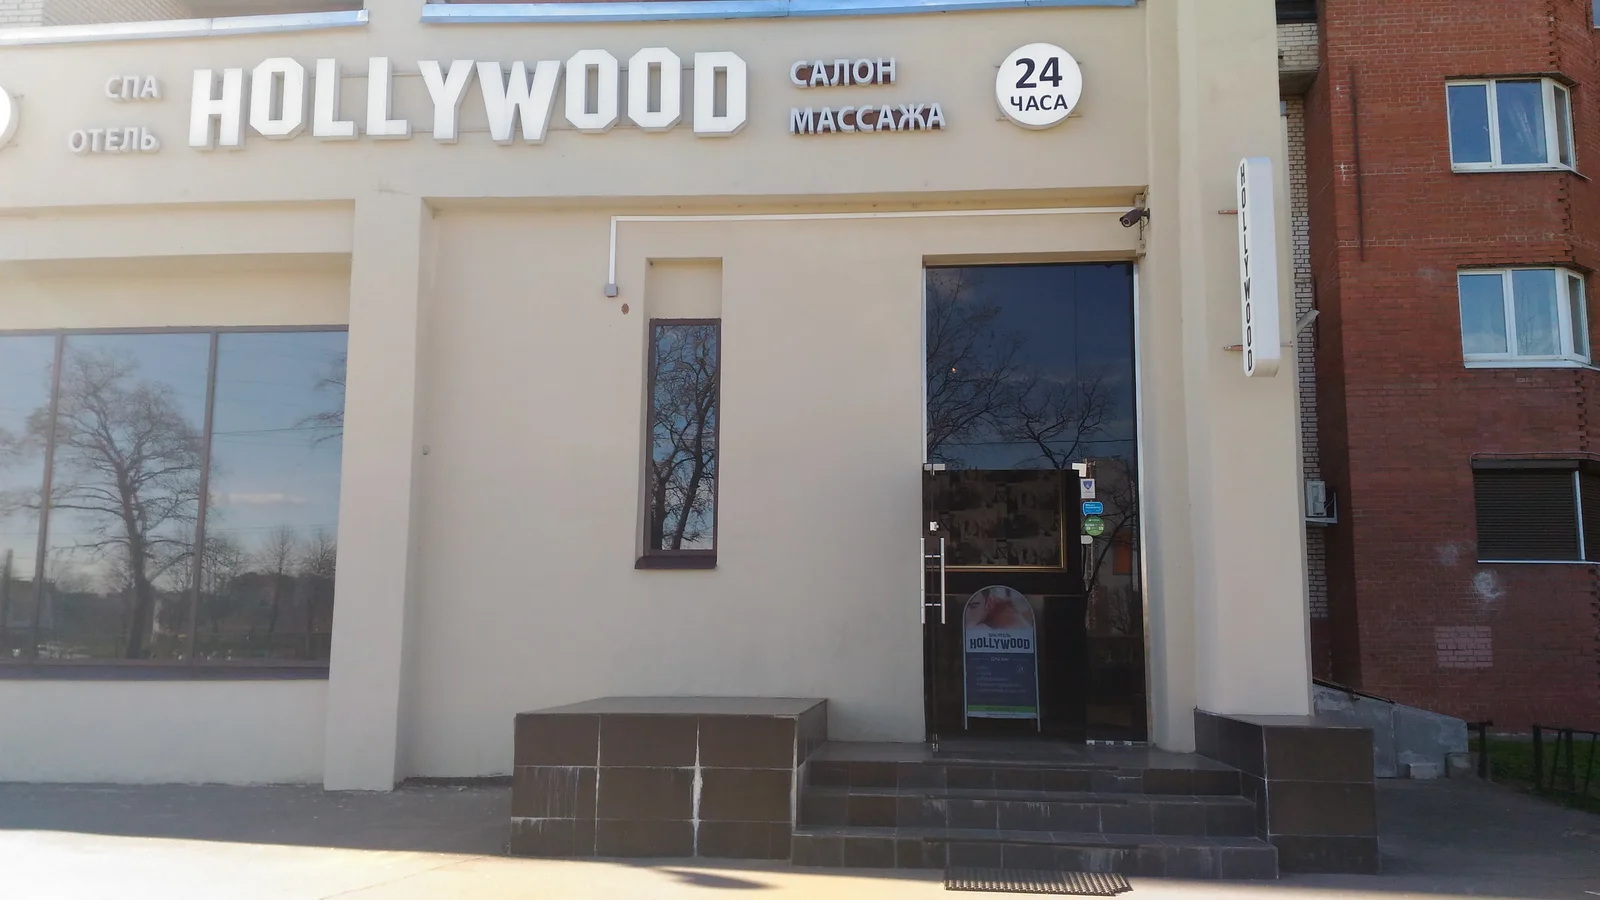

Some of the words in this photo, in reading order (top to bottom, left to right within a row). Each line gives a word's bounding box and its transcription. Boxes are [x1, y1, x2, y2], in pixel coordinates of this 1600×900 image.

[105, 74, 160, 100] СПА
[789, 57, 896, 87] САЛОН
[1015, 57, 1063, 89] 24
[188, 47, 748, 149] HOLLYWOOD
[1010, 94, 1069, 112] ЧАСА
[789, 102, 946, 134] МАССАЖА
[69, 126, 160, 153] ОТЕЛЬ
[1239, 164, 1253, 372] HOLLYWOOD
[969, 637, 1030, 650] HOLLYWOOD
